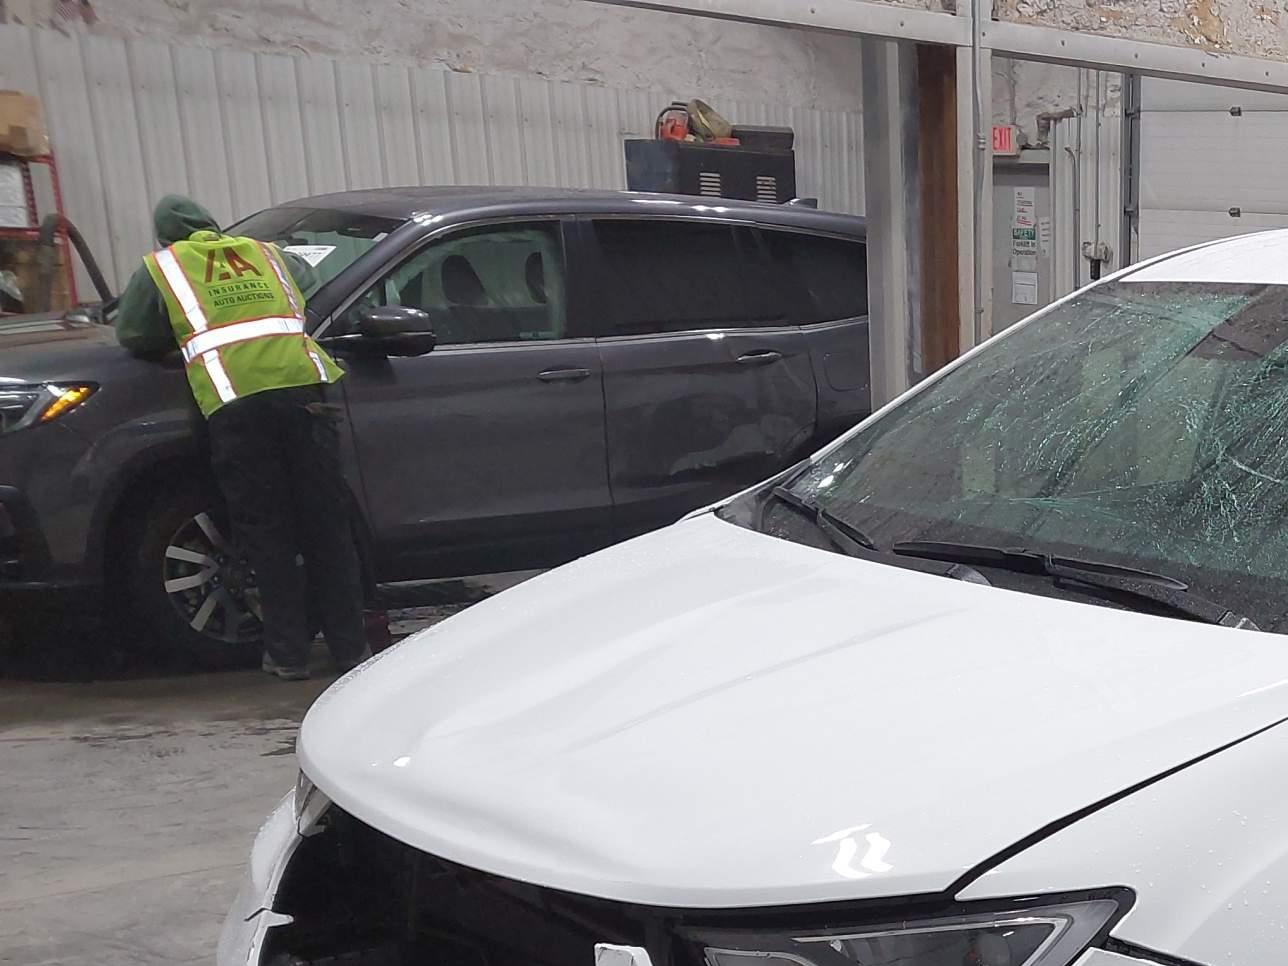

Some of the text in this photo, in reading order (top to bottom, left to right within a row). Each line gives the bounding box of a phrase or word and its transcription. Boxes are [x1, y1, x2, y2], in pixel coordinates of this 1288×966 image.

[993, 127, 1011, 150] EXIT
[208, 282, 269, 297] INSURANCE
[214, 292, 274, 307] AUTO AUCTIONS
